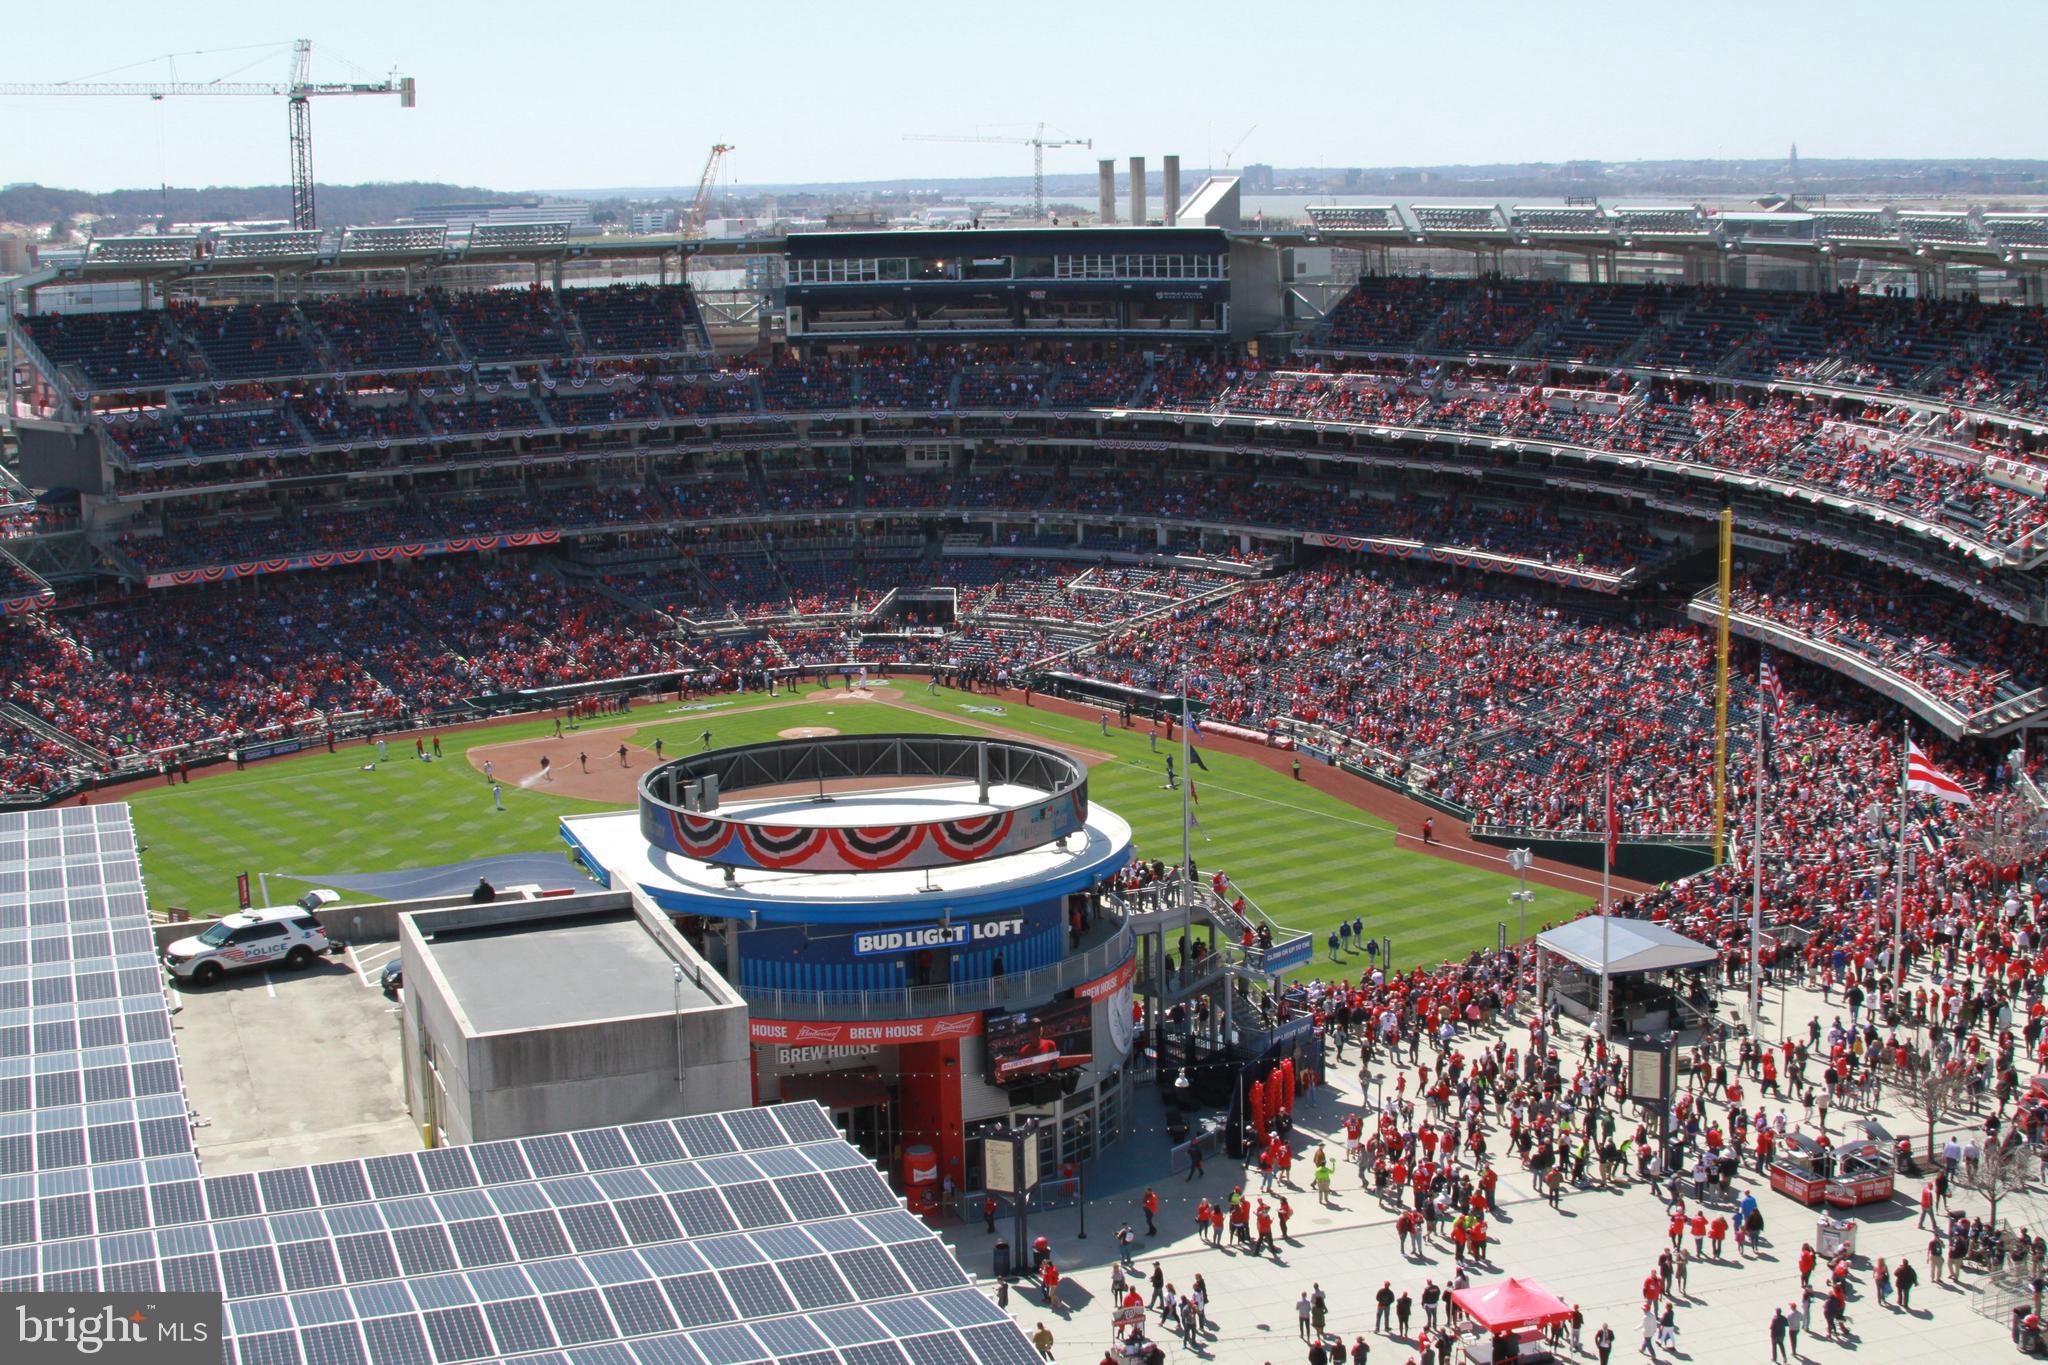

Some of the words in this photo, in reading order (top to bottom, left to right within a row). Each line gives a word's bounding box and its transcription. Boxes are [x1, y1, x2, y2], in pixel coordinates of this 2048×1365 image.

[858, 932, 903, 953] BUD
[973, 919, 1024, 940] LOFT
[244, 943, 289, 957] POLICE
[751, 1024, 788, 1038] HOUSE
[849, 1027, 883, 1040] BREW
[885, 1024, 923, 1038] HOUSE
[780, 1045, 823, 1065] BREW
[827, 1043, 881, 1058] HOUSE
